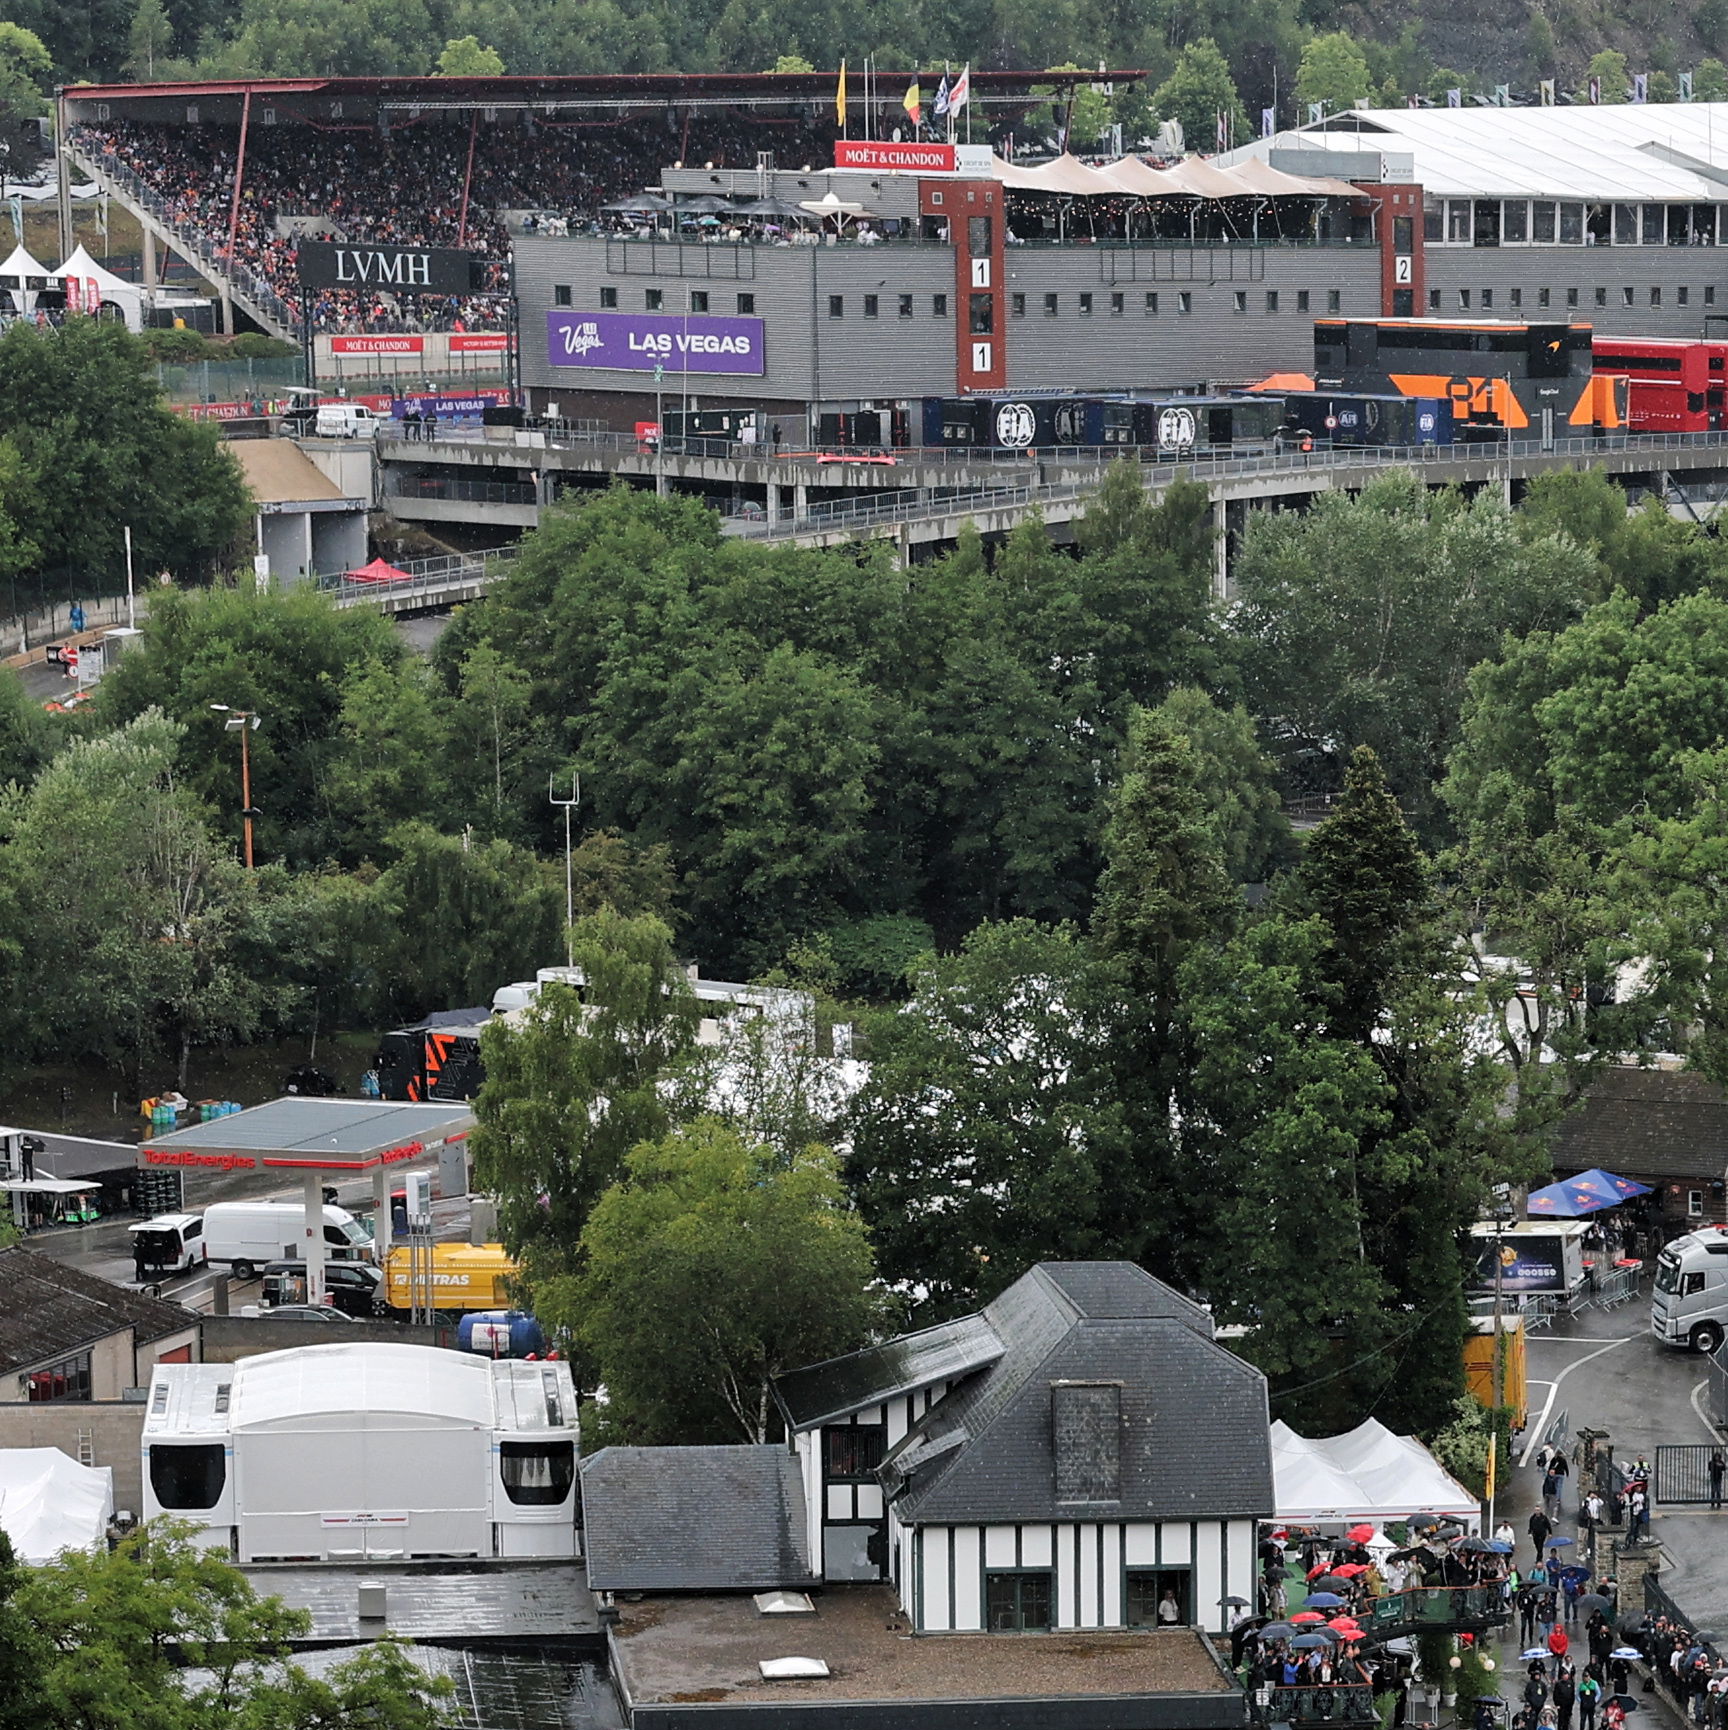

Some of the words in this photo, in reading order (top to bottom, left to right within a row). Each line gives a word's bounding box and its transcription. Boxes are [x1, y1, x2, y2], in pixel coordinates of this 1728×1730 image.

[846, 149, 878, 164] MOËT
[879, 151, 888, 164] &
[889, 151, 944, 167] CHANDON
[335, 250, 432, 286] LVMH
[979, 262, 984, 284] 1
[1400, 260, 1408, 280] 2
[346, 340, 368, 352] MOËT
[374, 341, 411, 352] CHANDON
[629, 333, 672, 351] LAS
[676, 334, 750, 354] VEGAS
[979, 346, 985, 368] 1
[435, 402, 453, 411] LAS
[454, 401, 484, 410] VEGAS
[999, 409, 1034, 442] FIA
[1160, 413, 1194, 446] FIA
[143, 1150, 256, 1171] TotalEnergies
